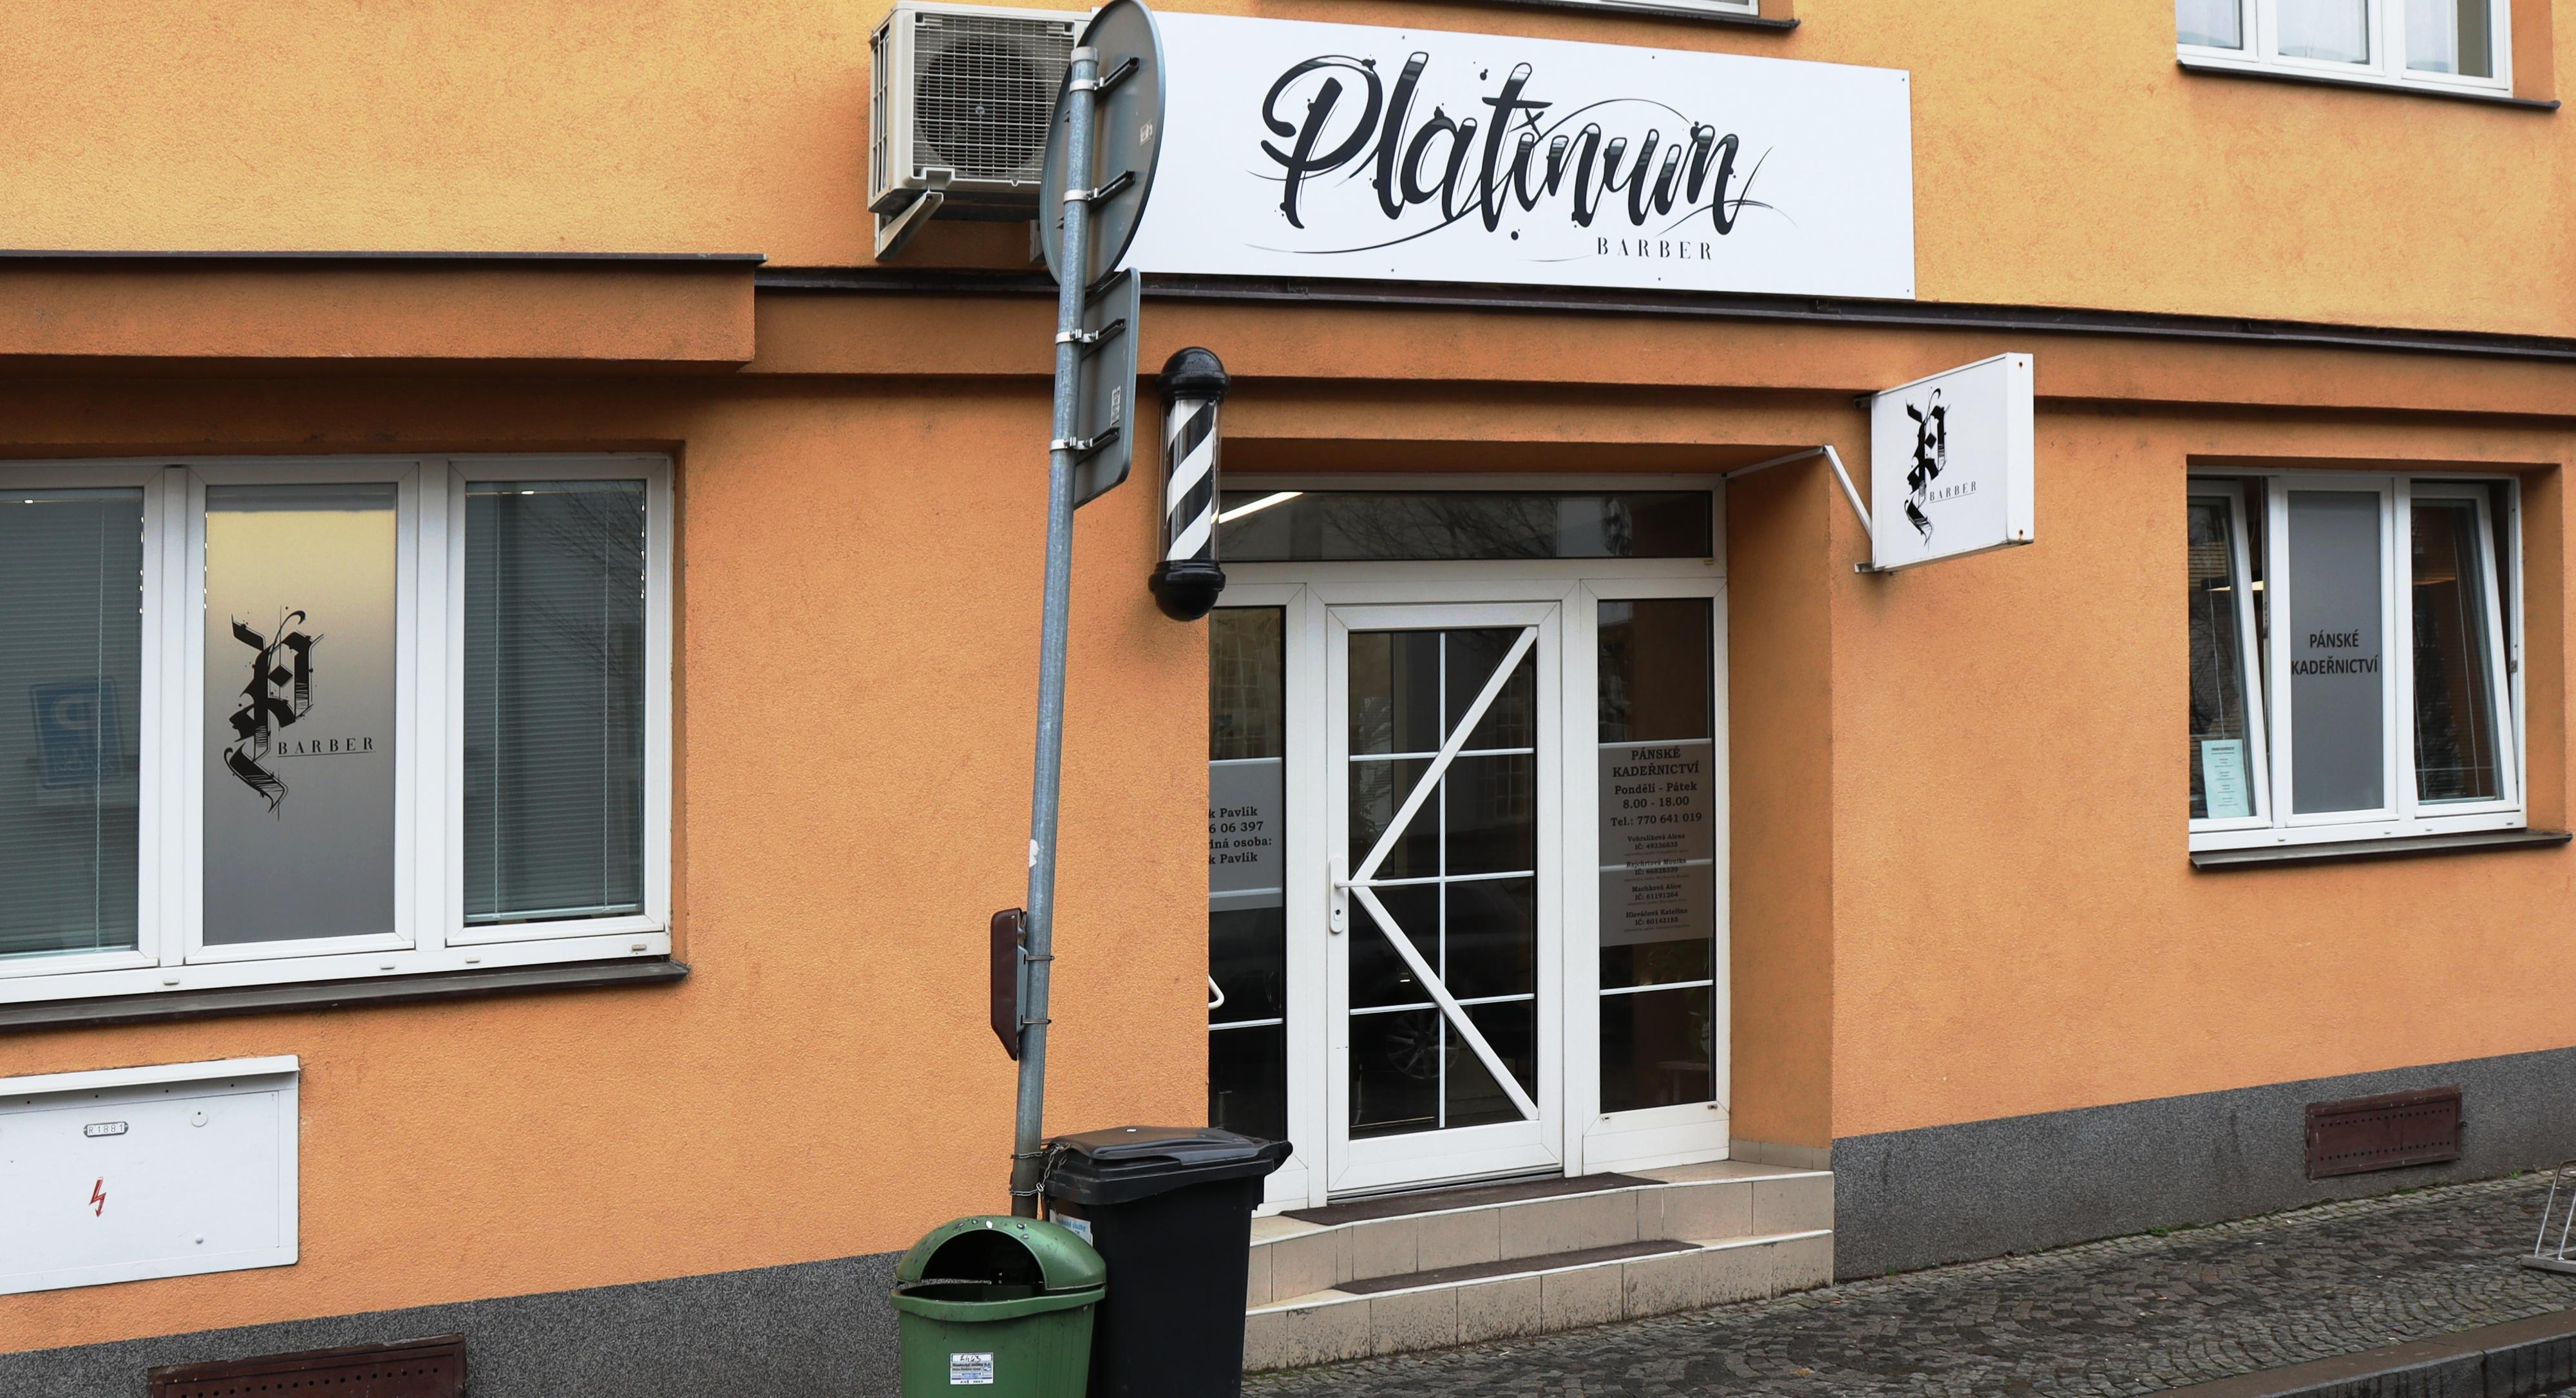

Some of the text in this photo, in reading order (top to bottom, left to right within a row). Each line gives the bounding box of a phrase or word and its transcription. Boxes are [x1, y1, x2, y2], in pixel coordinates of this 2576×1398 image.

[1251, 51, 1758, 242] Platinum
[1597, 237, 1712, 260] BARBER
[1929, 481, 1977, 501] BARBER
[2309, 629, 2359, 648] PÁNSKÉ
[2291, 655, 2379, 675] KADEŘNICTVÍ
[278, 737, 374, 755] BARBER
[1631, 746, 1681, 760] PÁNSKÉ
[1613, 760, 1699, 777] KADEŘNICTVÍ
[1667, 781, 1698, 792] Pátek
[1623, 798, 1647, 809] 8.00
[1659, 796, 1689, 807] 18.00
[1220, 806, 1258, 818] Pavlík
[1611, 812, 1702, 826] Tel.: 770 641 019
[1220, 823, 1236, 833] 06
[1240, 821, 1264, 833] 397
[1233, 836, 1272, 847] osoba:
[1220, 852, 1258, 864] Pavlík
[88, 1123, 123, 1134] R1881
